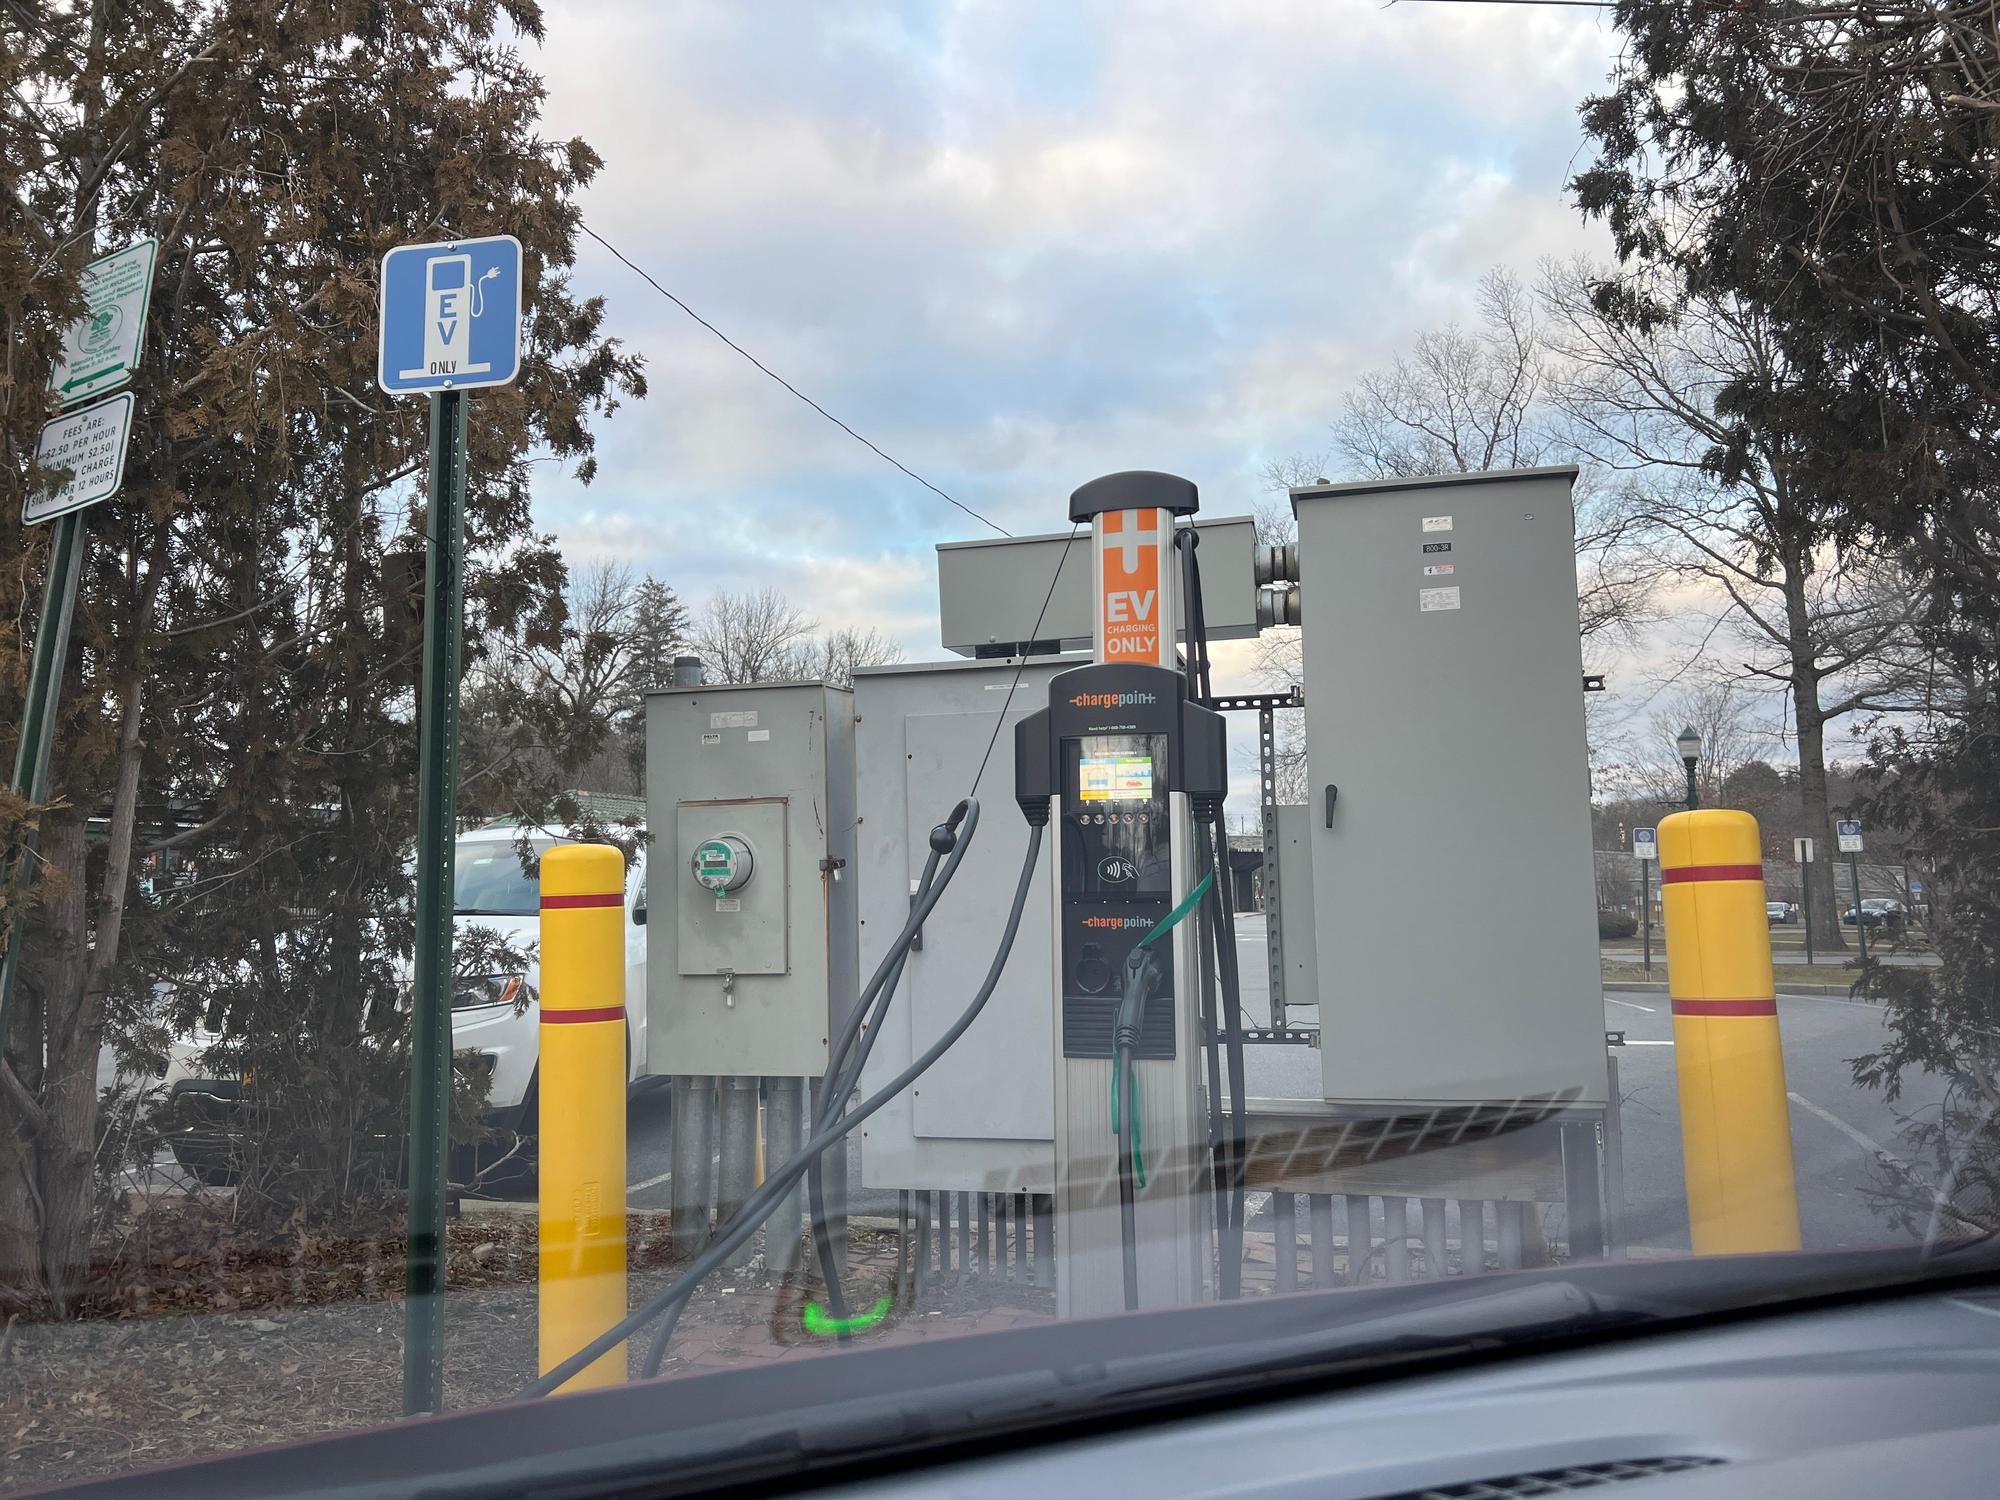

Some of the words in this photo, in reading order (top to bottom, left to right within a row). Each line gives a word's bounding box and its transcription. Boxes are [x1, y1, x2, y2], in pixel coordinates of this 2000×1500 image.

[437, 293, 457, 346] EV
[430, 360, 457, 375] ONLY
[63, 425, 83, 439] FEES
[86, 417, 105, 431] ARE:
[72, 437, 89, 450] PER
[92, 426, 116, 443] HOUR
[44, 451, 85, 470] MINIMUM
[81, 455, 115, 475] CHARGE
[78, 480, 86, 492] 12
[88, 470, 115, 488] HOURS
[1107, 590, 1156, 623] EV
[1107, 623, 1156, 634] CHARGING
[1107, 636, 1157, 654] ONLY
